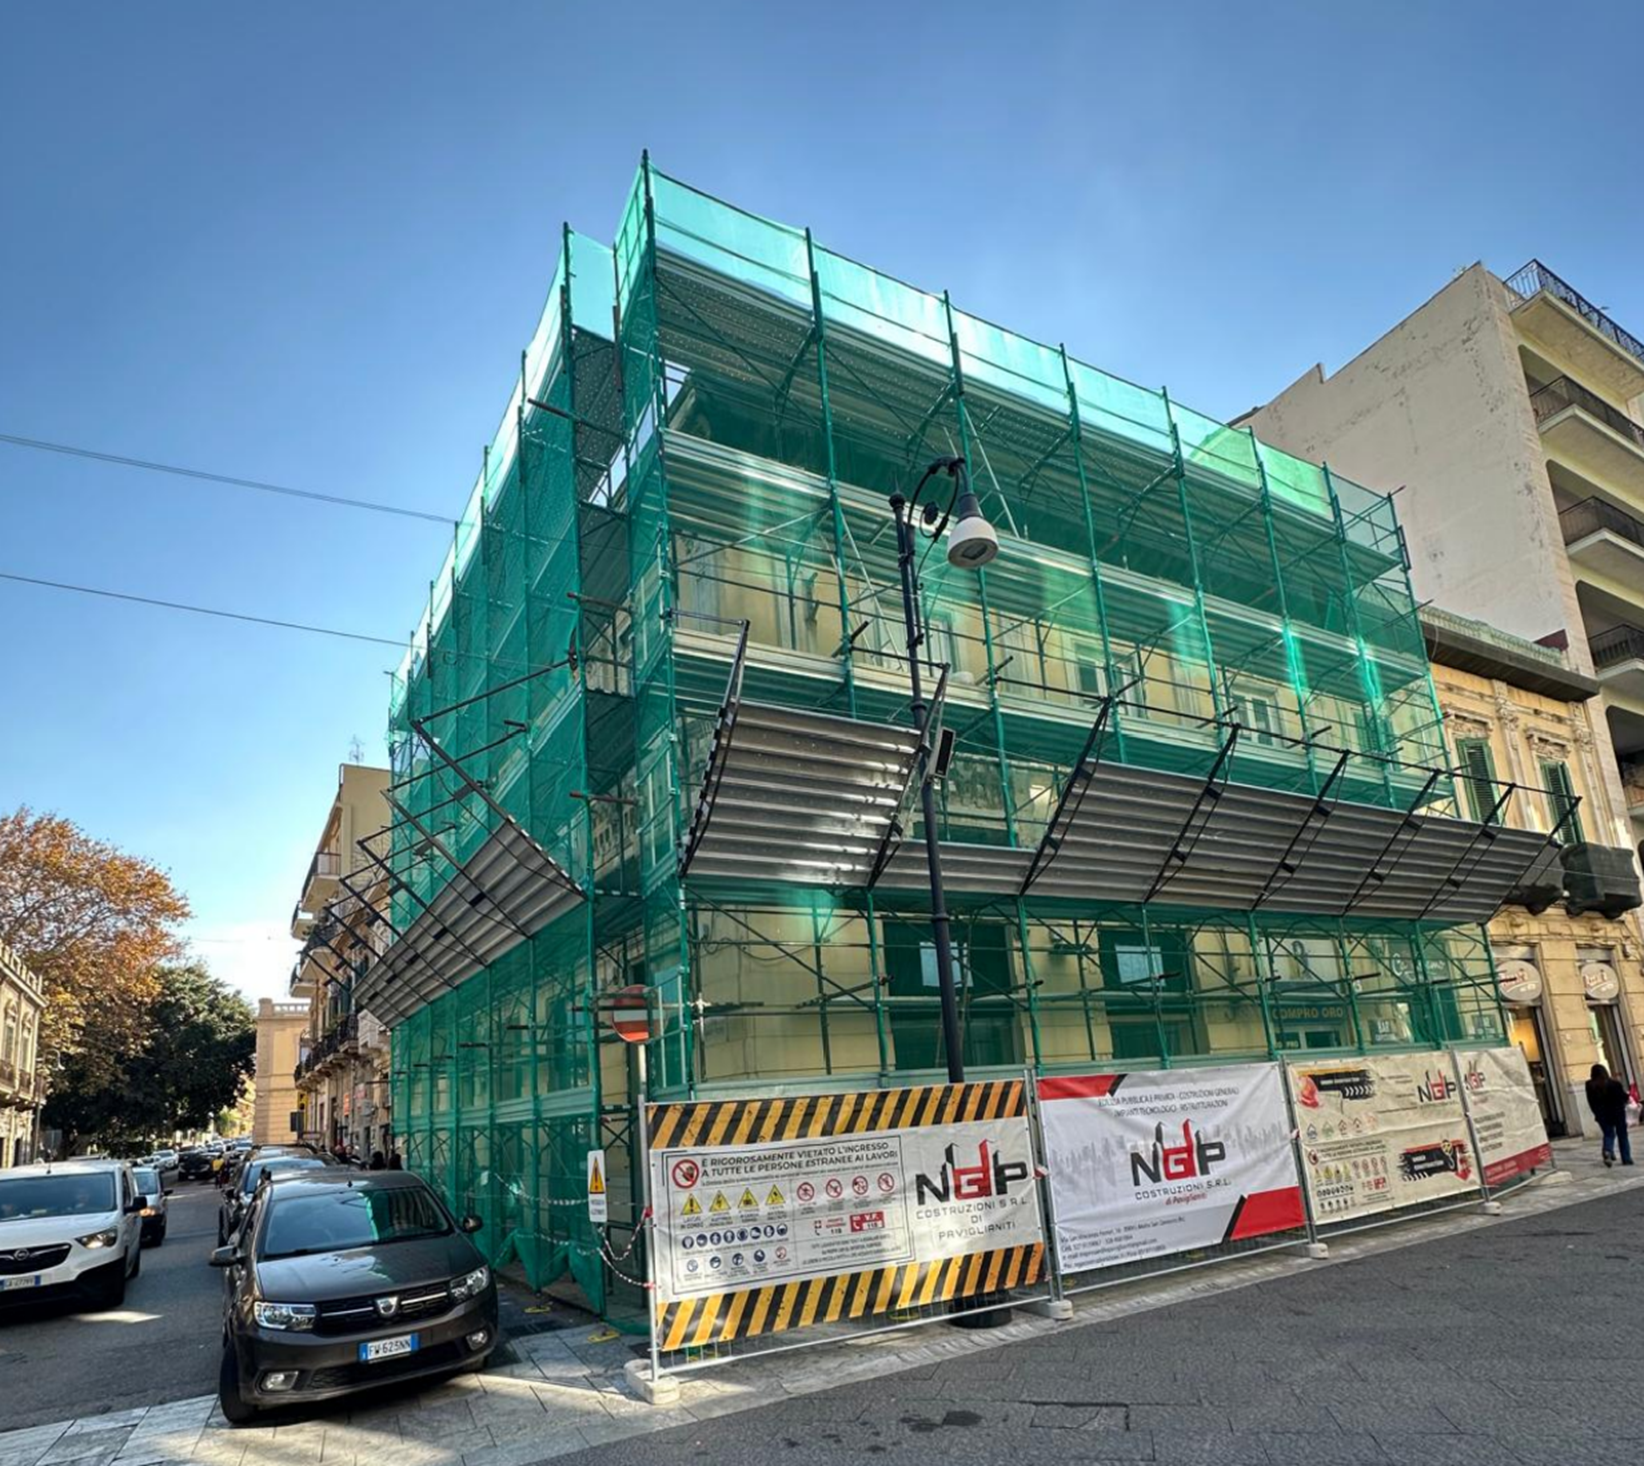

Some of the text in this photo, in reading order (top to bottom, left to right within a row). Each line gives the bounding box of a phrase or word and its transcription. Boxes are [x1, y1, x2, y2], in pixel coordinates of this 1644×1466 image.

[1272, 1006, 1344, 1019] COMPRO ORO
[1417, 1070, 1457, 1103] NGP
[710, 1151, 795, 1166] RIGOROSAMENTE
[797, 1147, 836, 1158] VIETATO
[838, 1142, 889, 1154] L'INGRESSO
[1130, 1118, 1226, 1187] NGP
[702, 1150, 898, 1178] A TUTTE LE PERSONE ESTRANEE AI LAVORI
[1135, 1178, 1231, 1200] COSTRUZIONI S.R.L.
[916, 1201, 995, 1219] COSTRUZIONI
[971, 1215, 982, 1224] DI
[939, 1220, 1016, 1239] PAVIGLIANITI
